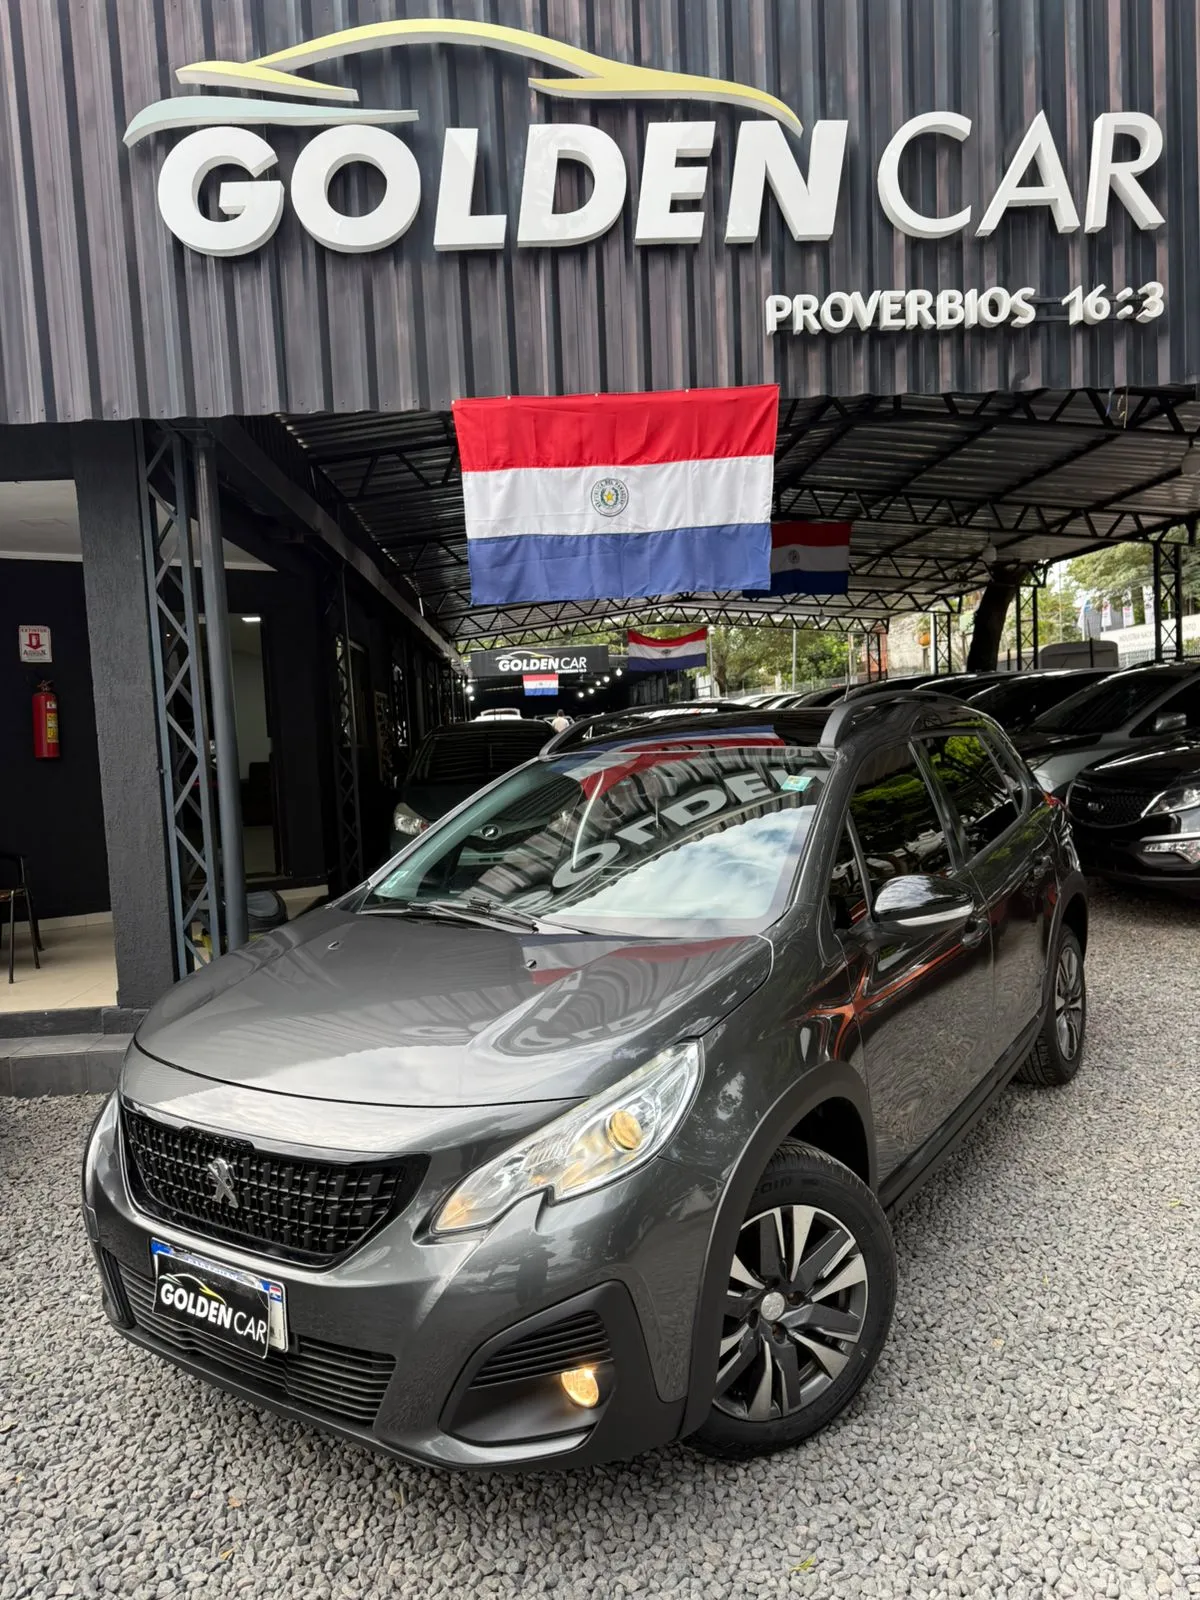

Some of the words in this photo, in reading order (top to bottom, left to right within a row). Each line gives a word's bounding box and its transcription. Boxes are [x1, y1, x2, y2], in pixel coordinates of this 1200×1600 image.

[158, 120, 848, 257] GOLDEN
[877, 109, 1167, 239] CAR
[766, 288, 1036, 335] PROVERBIOS
[1061, 281, 1165, 327] 16:3
[498, 658, 560, 671] GOLDEN
[561, 657, 587, 669] CAR
[160, 1282, 233, 1329] GOLDEN
[233, 1311, 267, 1344] CAR
